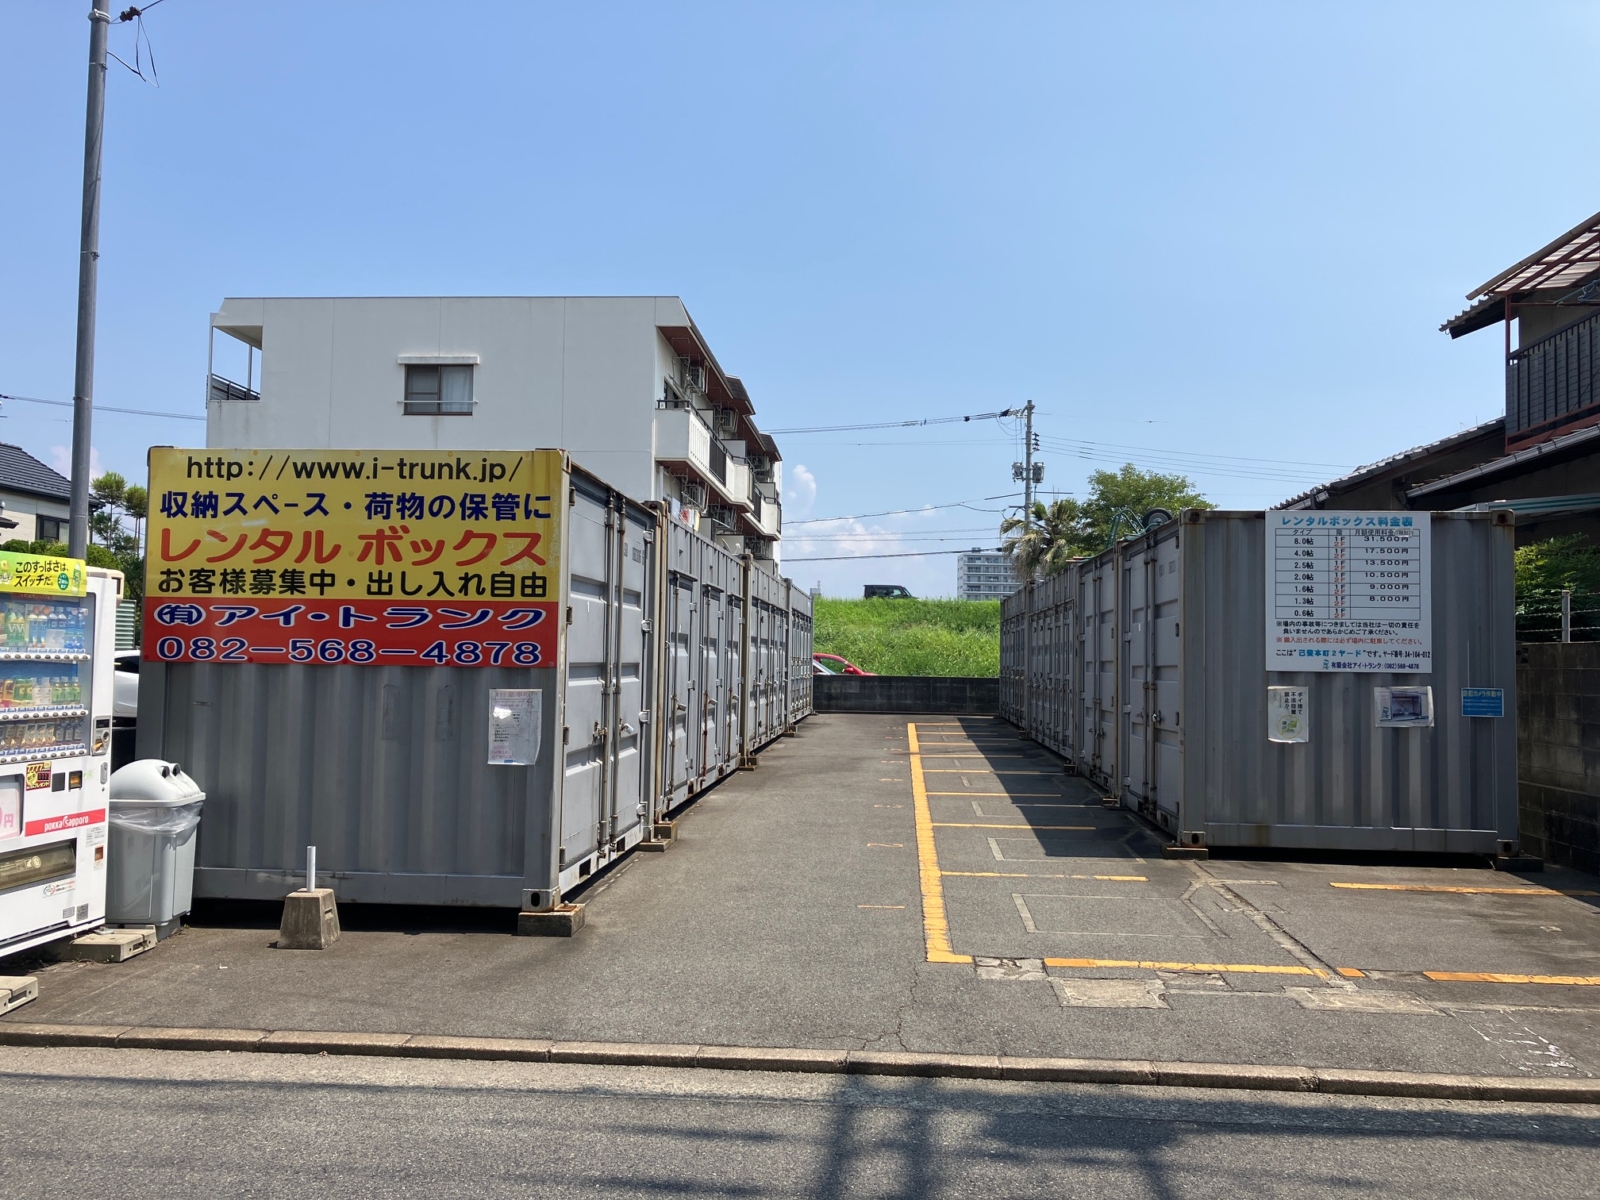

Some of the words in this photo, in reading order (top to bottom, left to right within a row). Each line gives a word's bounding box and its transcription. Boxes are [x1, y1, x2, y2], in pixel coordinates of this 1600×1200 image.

[187, 455, 523, 482] http://www.i-trunk.jp/
[160, 490, 551, 521] 収納スペース・荷物の保管に
[1282, 516, 1413, 527] レンタルボックス料金表
[158, 568, 547, 597] お客様募集中・出し入れ自由
